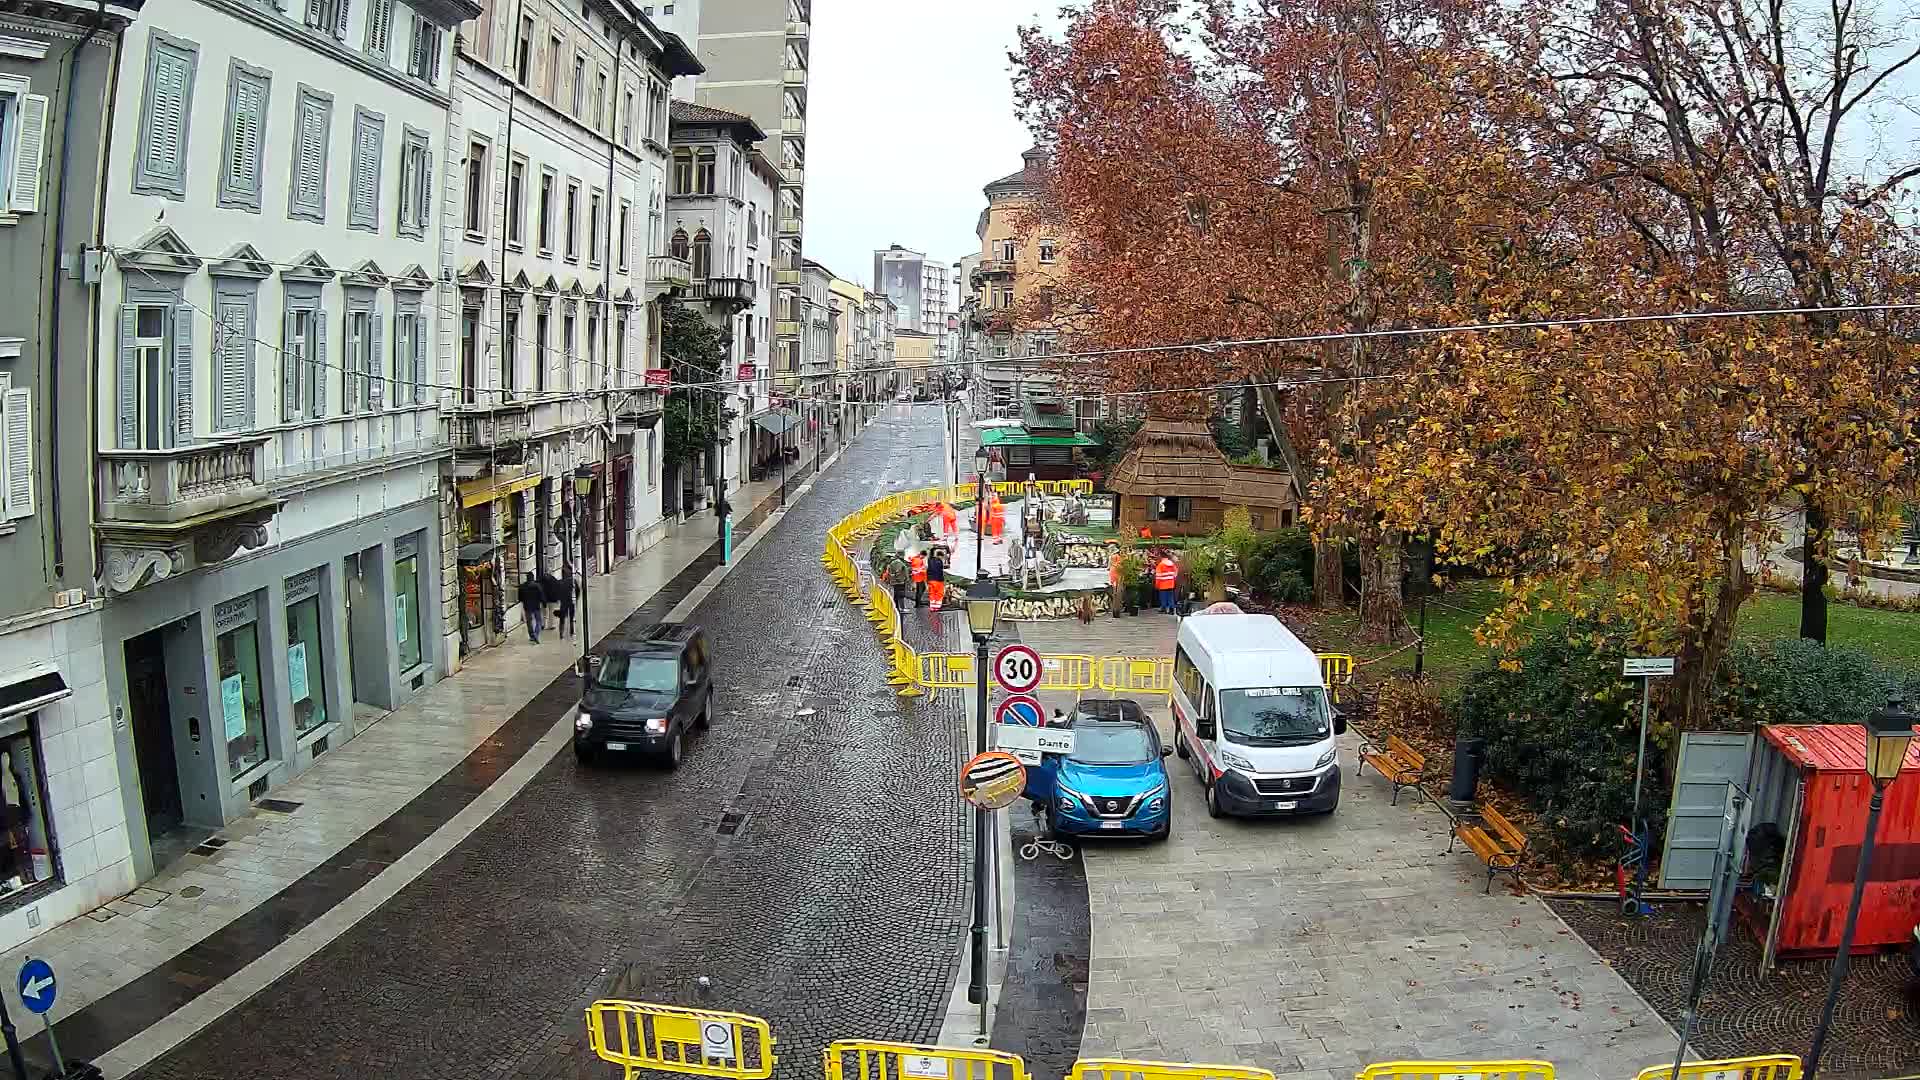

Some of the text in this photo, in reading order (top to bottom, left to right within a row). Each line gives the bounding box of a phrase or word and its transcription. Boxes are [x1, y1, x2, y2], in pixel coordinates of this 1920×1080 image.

[1006, 658, 1033, 680] 30
[1282, 687, 1302, 696] CIVILE
[1038, 738, 1070, 749] Dante
